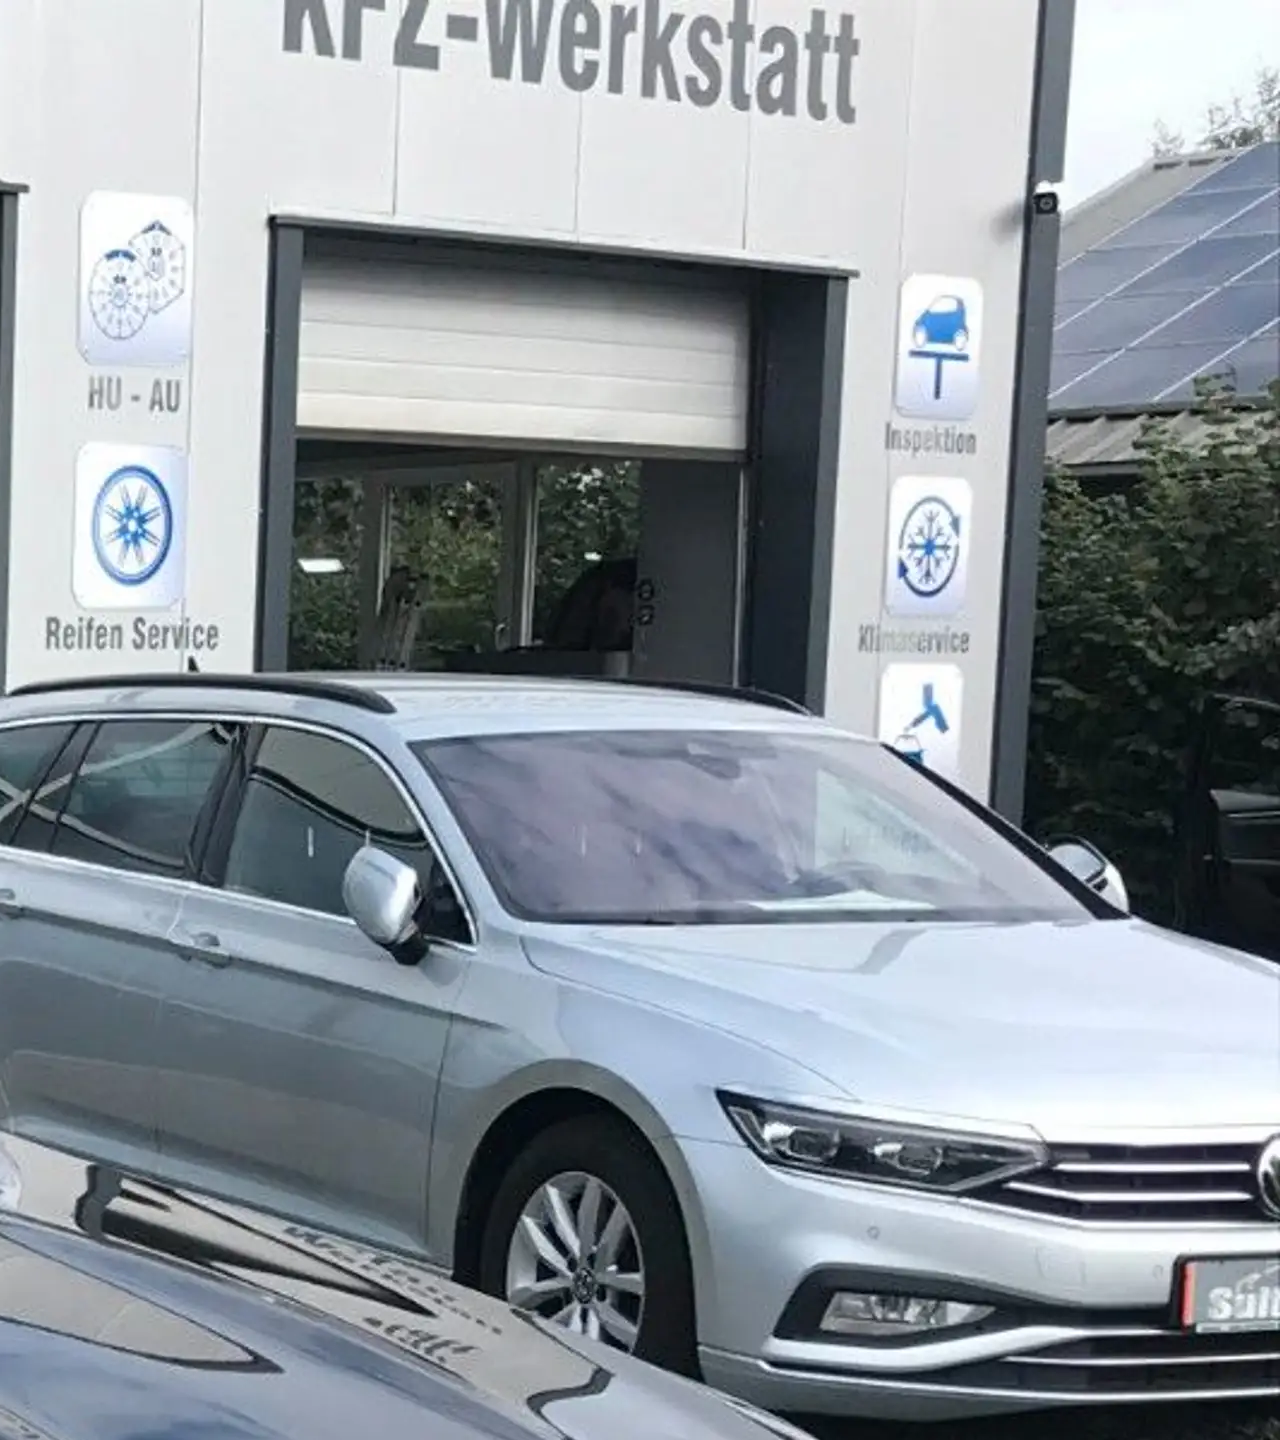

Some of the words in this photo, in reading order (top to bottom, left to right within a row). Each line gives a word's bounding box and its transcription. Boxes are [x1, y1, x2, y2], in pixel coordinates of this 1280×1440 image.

[88, 375, 122, 411] HU
[148, 378, 182, 413] AU
[884, 421, 977, 458] Inspektion
[44, 616, 123, 651] Reifen
[131, 616, 220, 651] Service
[857, 622, 971, 655] Klimaservice
